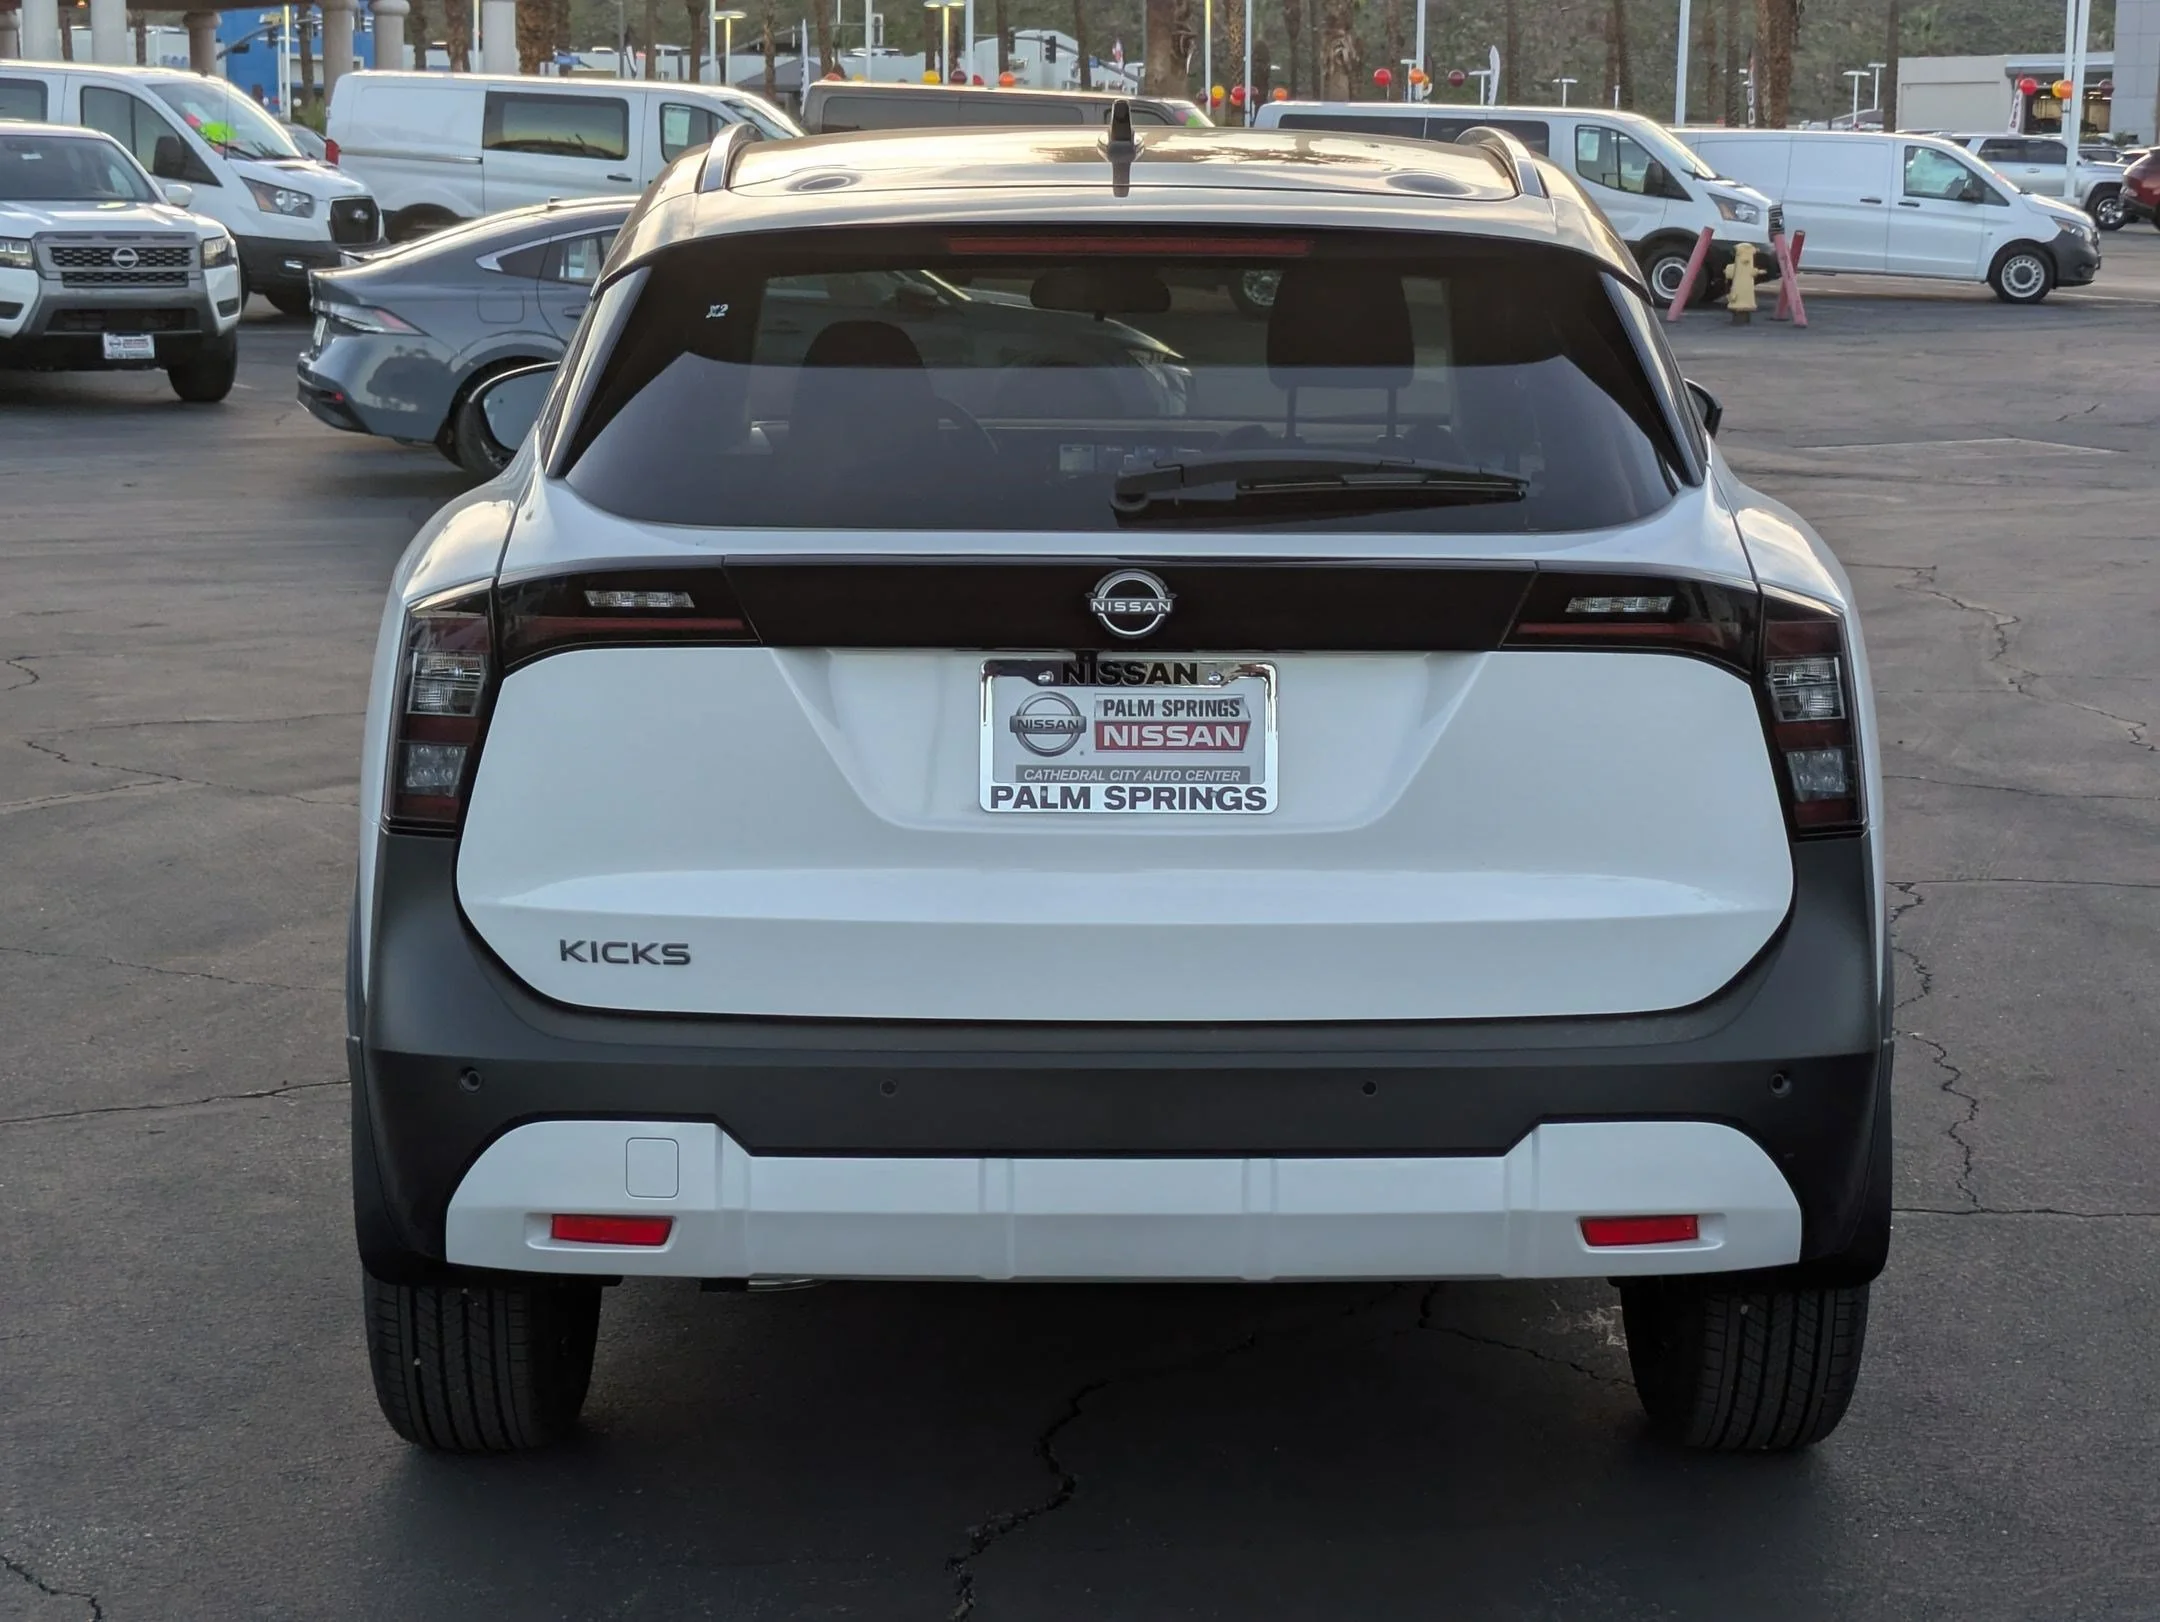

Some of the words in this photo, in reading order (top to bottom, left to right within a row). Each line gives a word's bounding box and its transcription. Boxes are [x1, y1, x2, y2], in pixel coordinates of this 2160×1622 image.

[1092, 601, 1171, 612] NISSAN
[1062, 662, 1198, 685] NISSAN
[1103, 699, 1155, 717] PALM
[1162, 699, 1241, 718] SPRINGS
[1017, 719, 1080, 730] NISSAN
[1103, 725, 1241, 747] NISSAN
[1024, 769, 1105, 782] CATHEDRAL
[1110, 769, 1139, 782] CITY
[1143, 769, 1182, 782] AUTO
[1185, 769, 1241, 782] CENTER
[991, 786, 1092, 809] PALM
[1104, 786, 1267, 810] SPRINGS
[559, 939, 691, 965] KICKS
